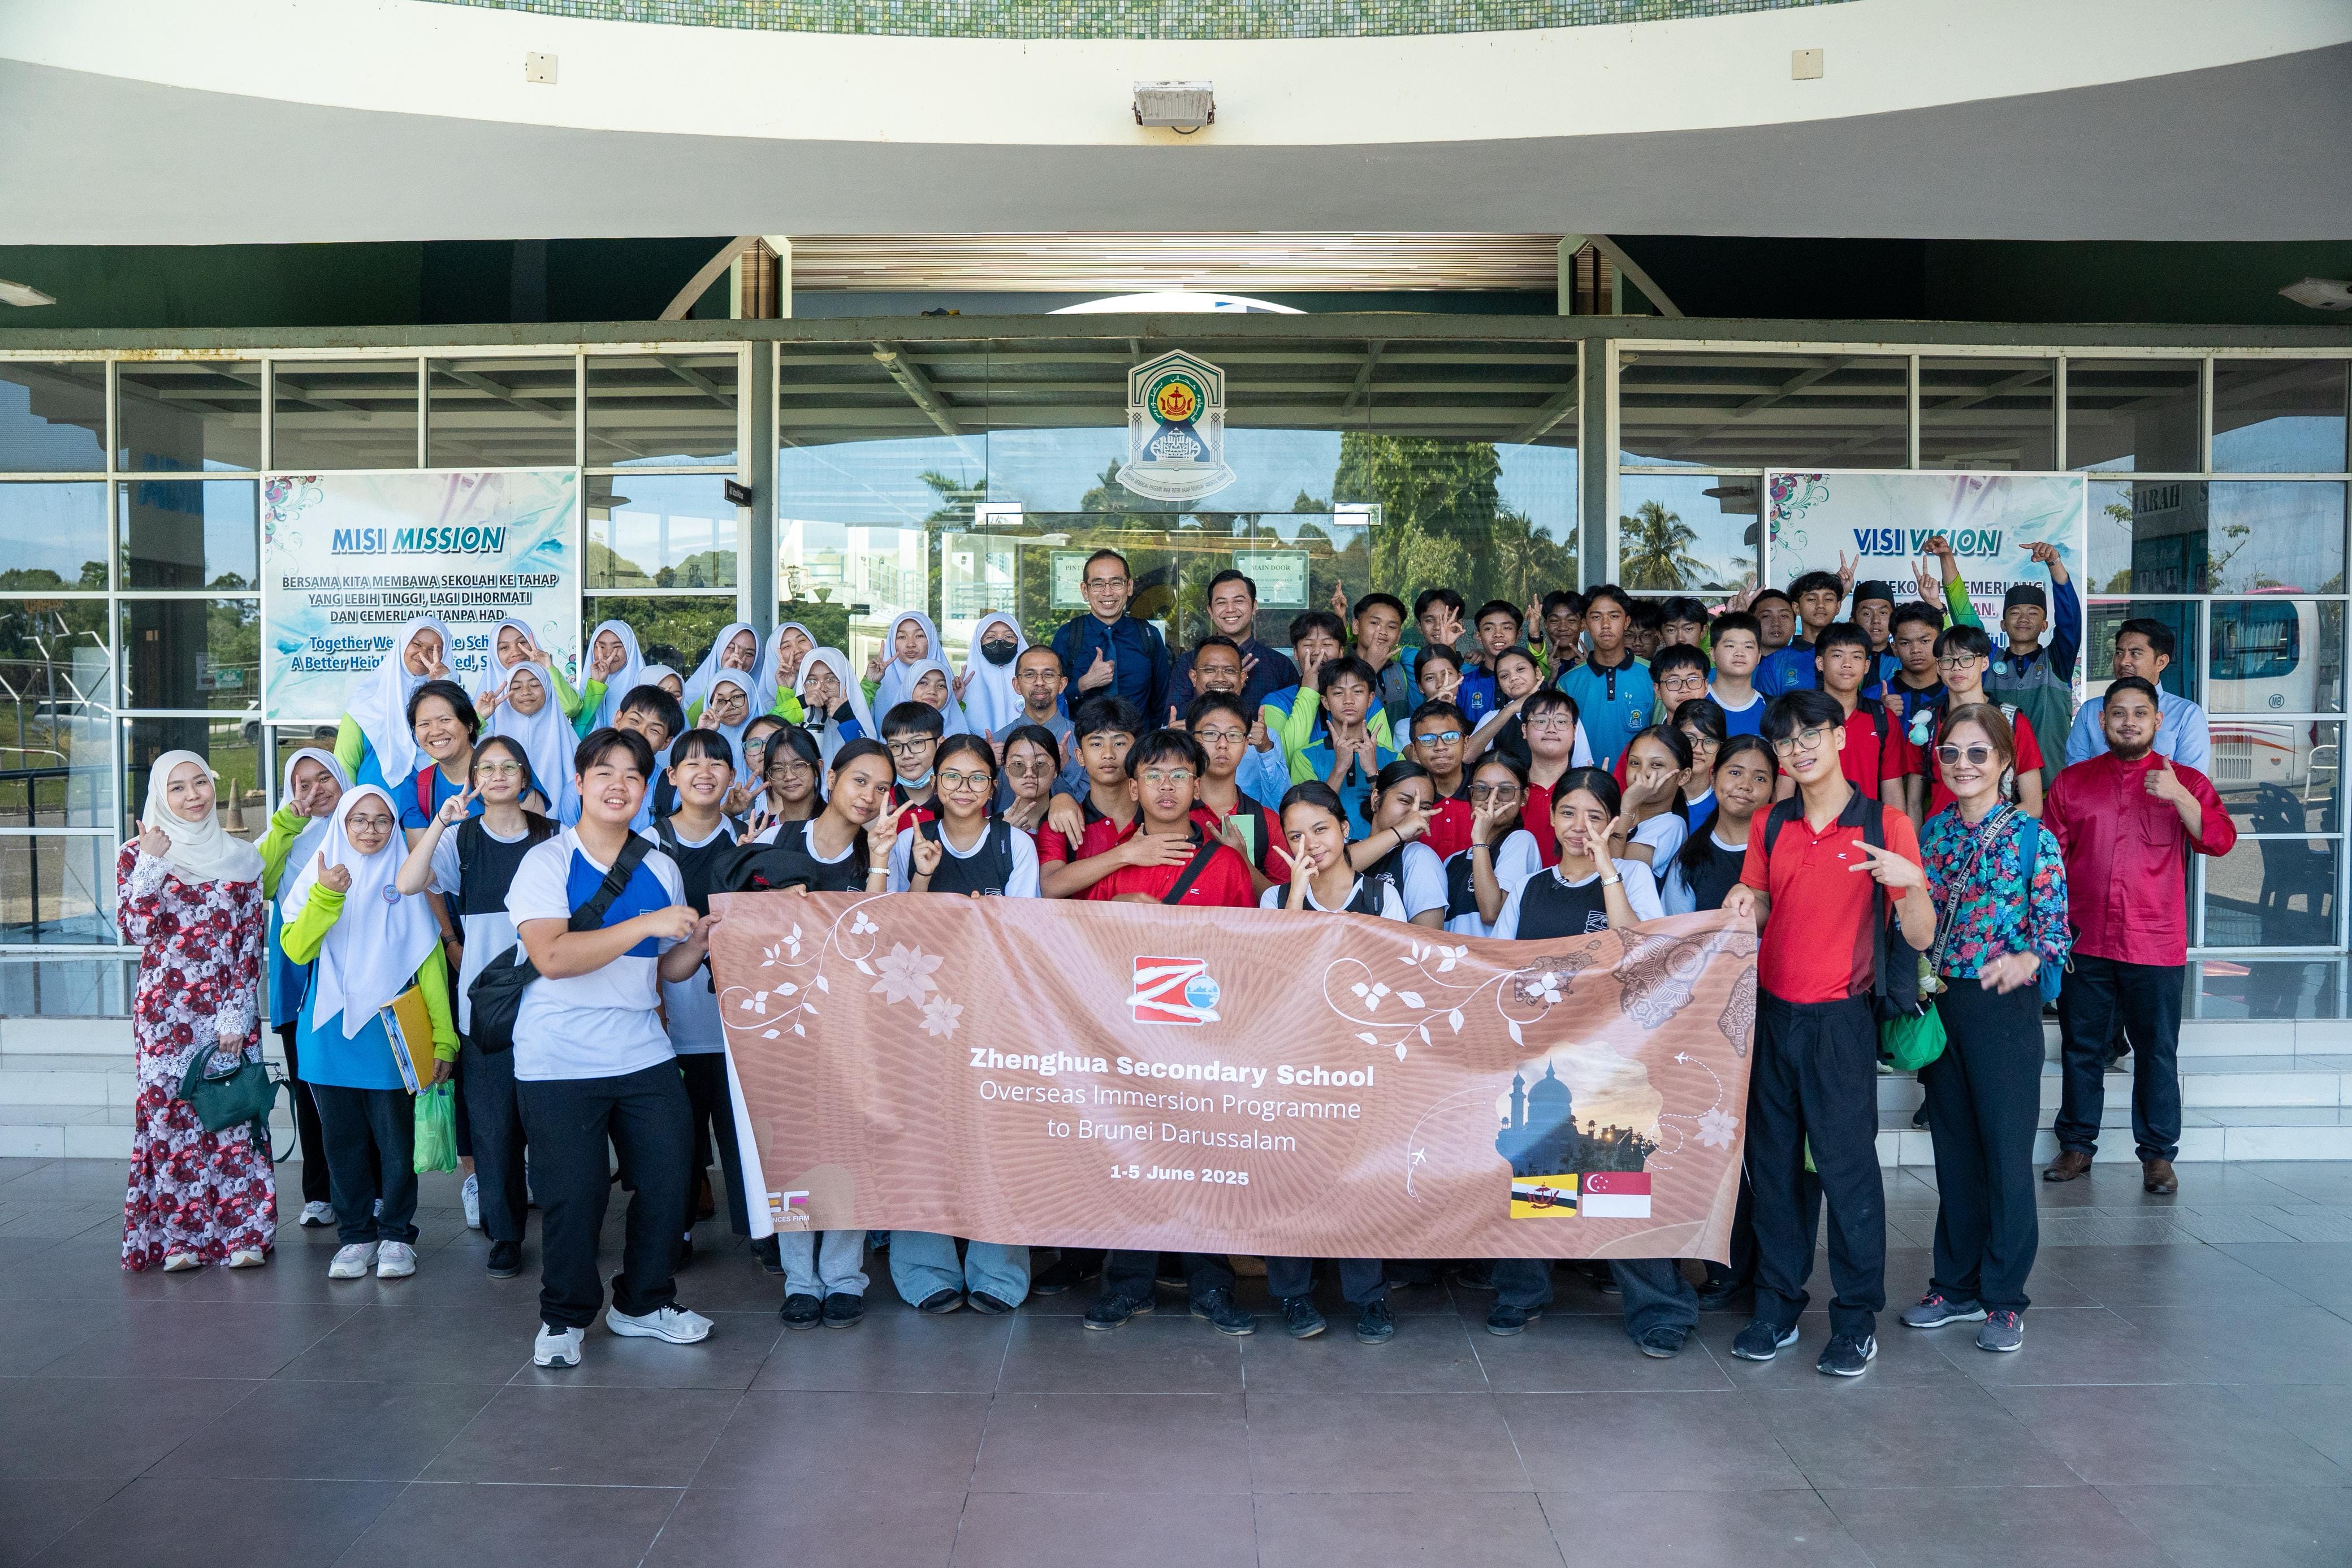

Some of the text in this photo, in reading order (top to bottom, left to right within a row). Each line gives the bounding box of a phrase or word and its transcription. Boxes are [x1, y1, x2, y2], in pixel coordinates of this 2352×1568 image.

[1123, 471, 1135, 482] SEKOLAH
[332, 527, 502, 551] MISI MISSION
[1853, 528, 1901, 551] VISI
[282, 574, 557, 588] BERSAMA KITA MEMBAWA SEKOLAH KE TAHAP
[1884, 581, 1945, 594] EKOH
[308, 592, 530, 606] YANG LEBIH TINGGI, LAGI DIHORMATI
[330, 610, 356, 622] DAN
[436, 610, 475, 621] TANPA
[310, 636, 370, 653] Together
[373, 636, 394, 648] We
[291, 657, 301, 669] A
[305, 657, 347, 669] Better
[1994, 812, 2010, 829] Brand
[1936, 933, 1945, 952] Brand
[969, 1047, 1374, 1088] Zhenghua Secondary School
[979, 1080, 1361, 1122] Overseas Immersion Programme
[1047, 1119, 1296, 1151] to Brunei Darussalam
[1110, 1164, 1249, 1185] 1-5 June 2025
